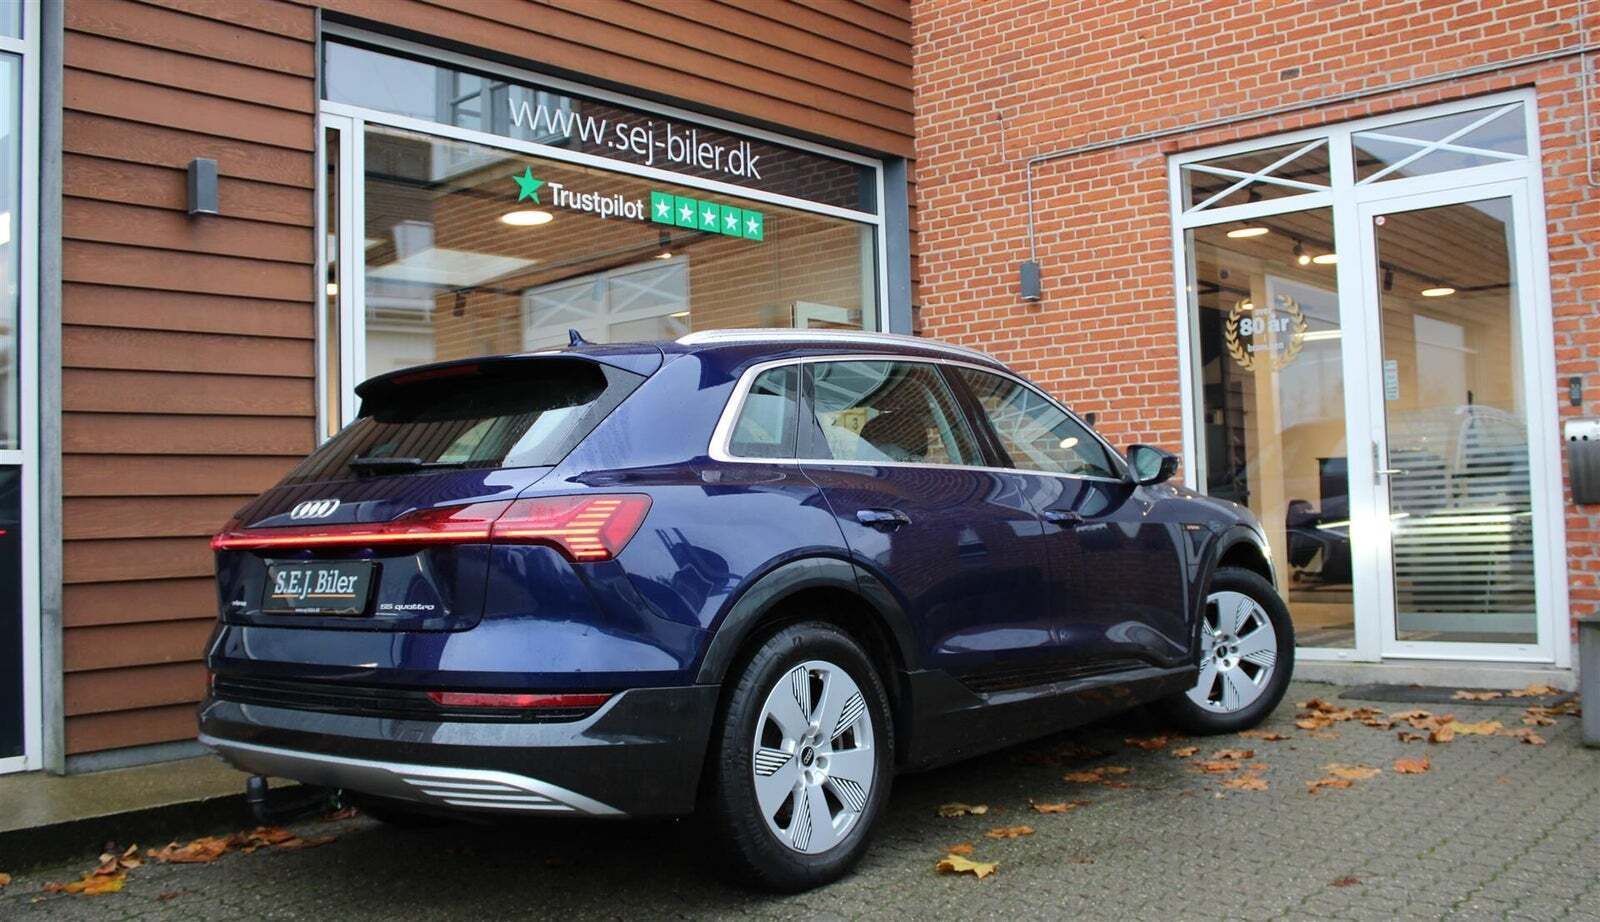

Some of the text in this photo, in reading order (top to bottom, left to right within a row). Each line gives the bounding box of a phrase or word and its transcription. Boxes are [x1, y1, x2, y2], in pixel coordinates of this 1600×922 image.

[508, 97, 762, 180] www.sej-biler.dk
[548, 182, 645, 220] Trustpilot
[1240, 317, 1265, 336] 80
[274, 569, 358, 600] S.E.J. Biler
[395, 603, 435, 611] quattro
